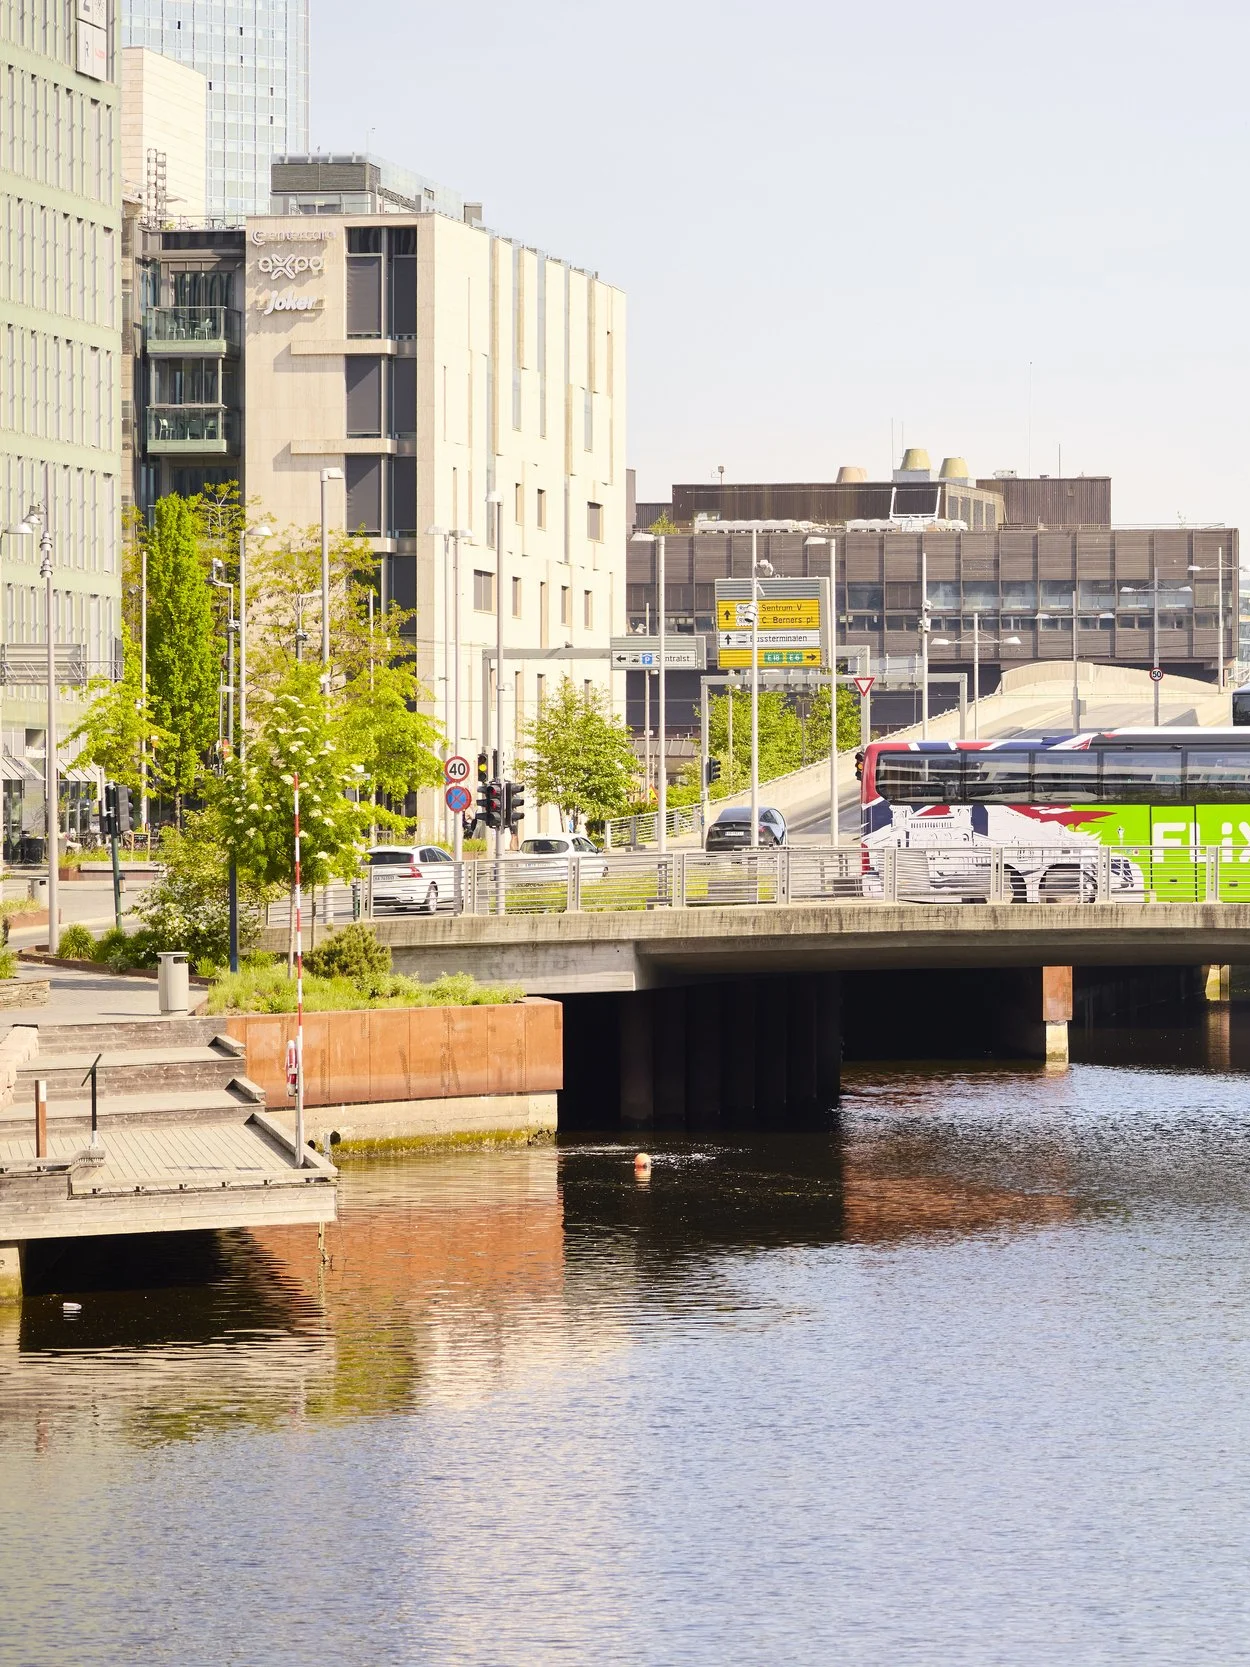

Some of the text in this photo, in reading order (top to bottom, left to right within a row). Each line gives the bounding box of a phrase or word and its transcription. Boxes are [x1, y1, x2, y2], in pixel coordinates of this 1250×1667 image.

[259, 254, 323, 280] axpo
[761, 604, 793, 612] Sentrum
[773, 616, 802, 624] Berners
[1152, 670, 1162, 678] 50
[448, 762, 466, 776] 40
